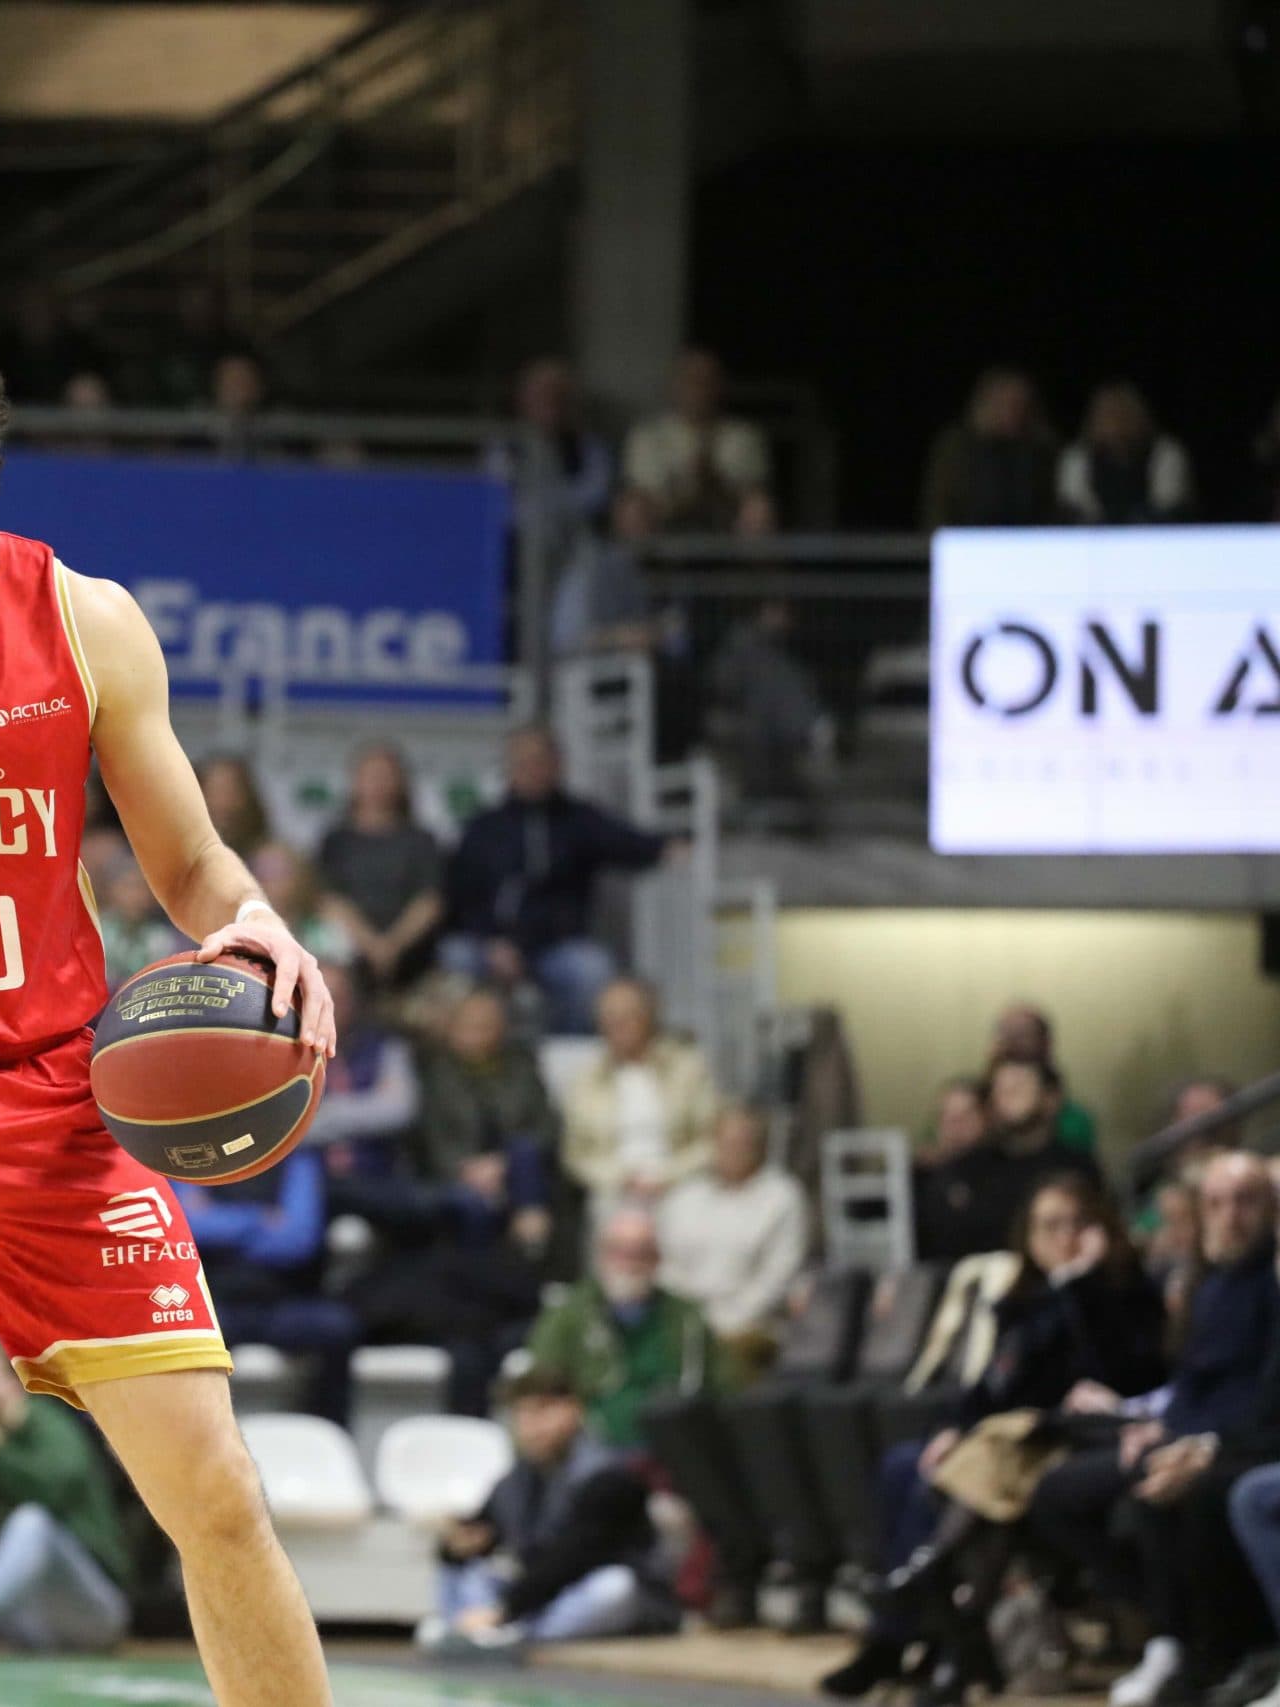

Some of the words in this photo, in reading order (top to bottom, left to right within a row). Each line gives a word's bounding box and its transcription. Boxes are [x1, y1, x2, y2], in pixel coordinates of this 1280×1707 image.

[962, 620, 1160, 716] ON
[11, 697, 71, 720] ACTILOC
[101, 1241, 198, 1267] EIFFAGE
[152, 1308, 194, 1324] errea
